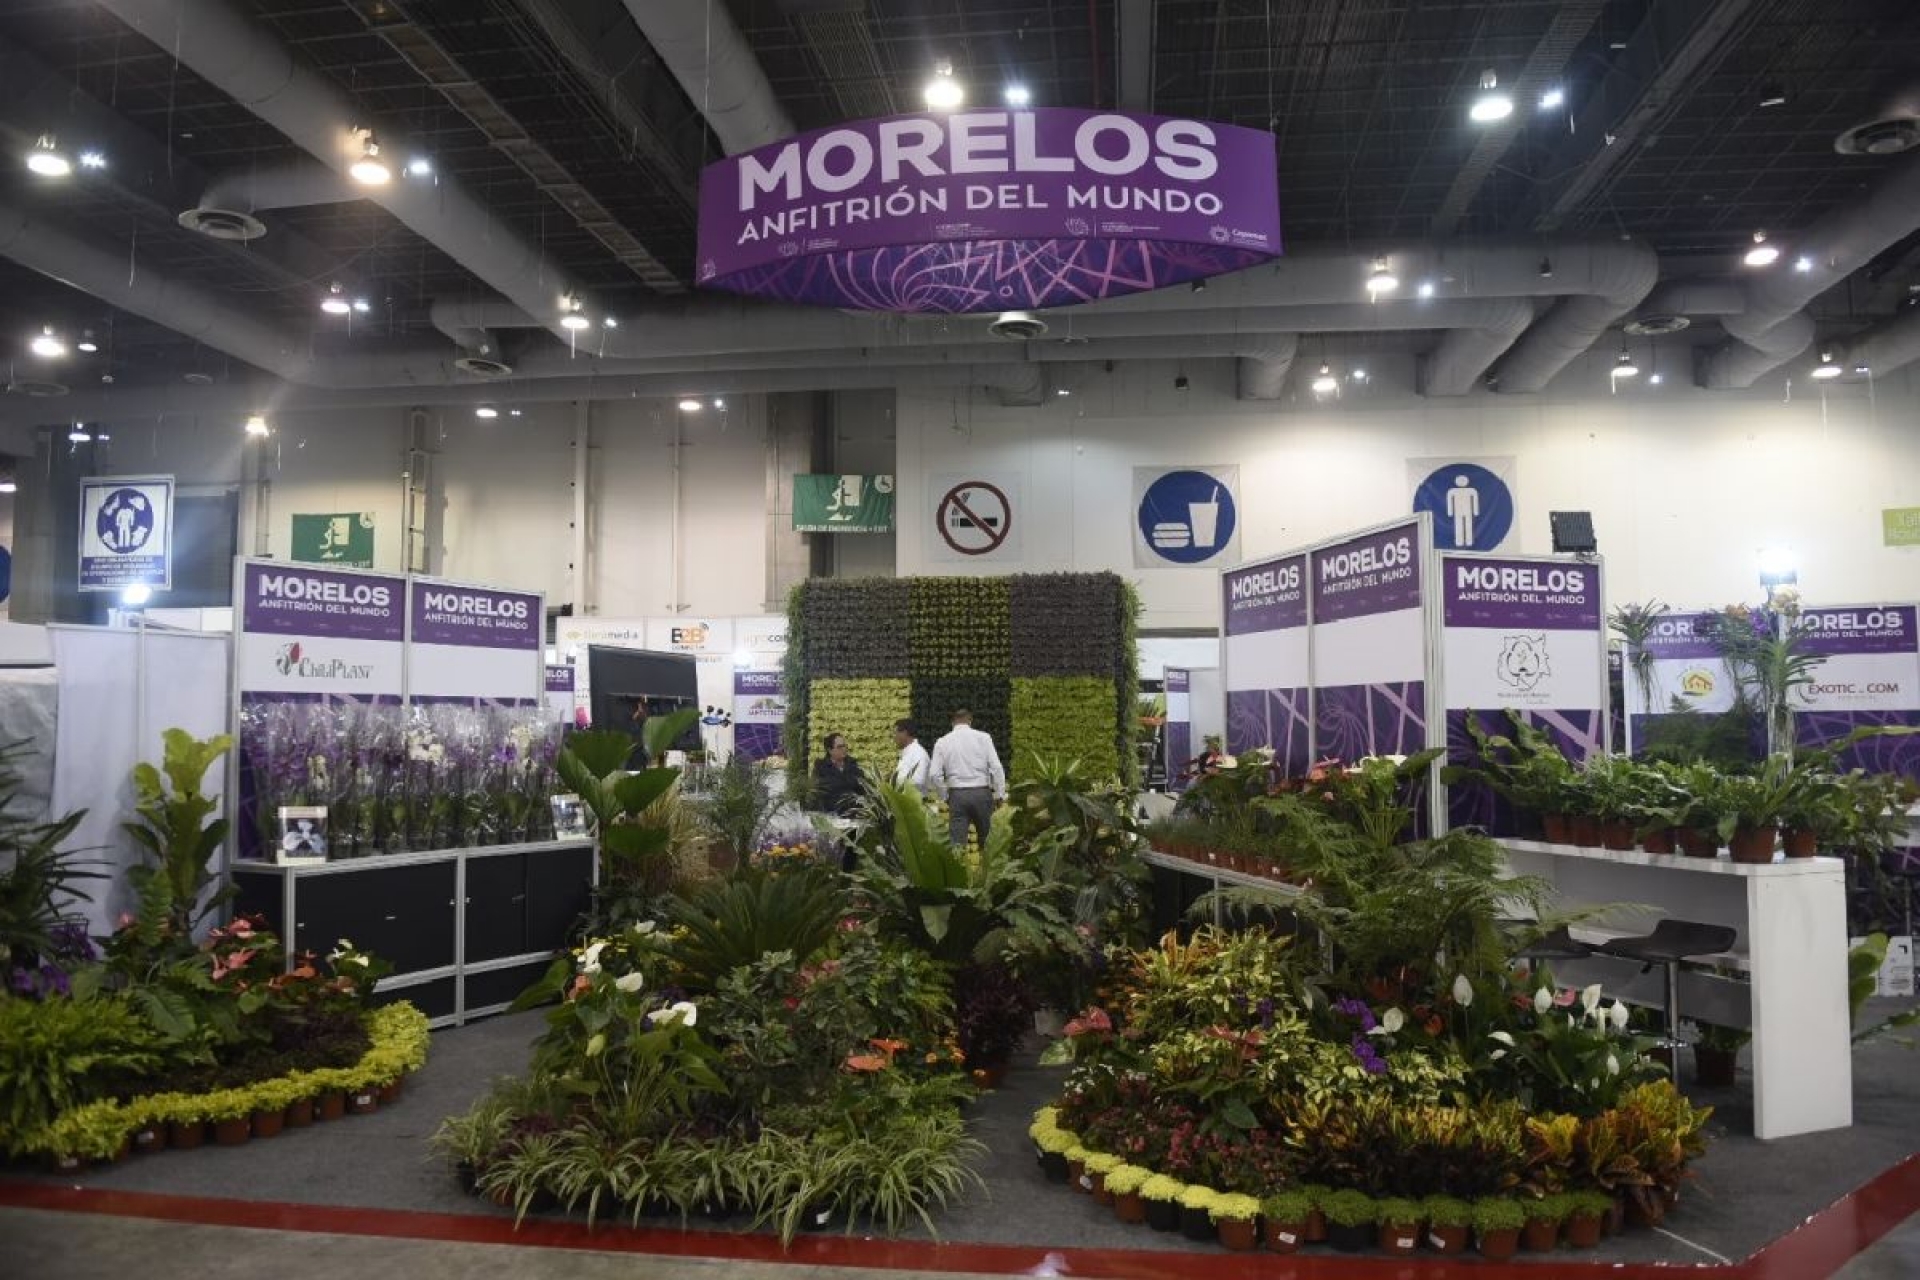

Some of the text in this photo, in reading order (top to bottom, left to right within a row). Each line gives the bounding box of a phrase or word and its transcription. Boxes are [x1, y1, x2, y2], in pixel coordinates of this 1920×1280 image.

[738, 112, 1220, 210] MORELOS
[737, 186, 948, 246] ANFITRIÓN
[966, 184, 1048, 210] DEL
[1067, 184, 1223, 216] MUNDO
[1322, 537, 1410, 582] MORELOS
[1232, 565, 1300, 599] MORELOS
[1363, 574, 1378, 588] DEL
[1382, 567, 1412, 583] MUNDO
[1457, 566, 1585, 592] MORELOS
[258, 574, 390, 607] MORELOS
[1277, 591, 1300, 602] MUNDO
[1458, 592, 1585, 604] ANFITRIÓN DEL MUNDO
[258, 600, 390, 617] ANFITRIÓN DEL MUNDO
[424, 592, 528, 618] MORELOS
[424, 613, 528, 630] ANFITRIÓN DEL MUNDO
[671, 628, 705, 644] B2B
[1808, 684, 1856, 694] EXOTIC
[1867, 683, 1899, 693] COM
